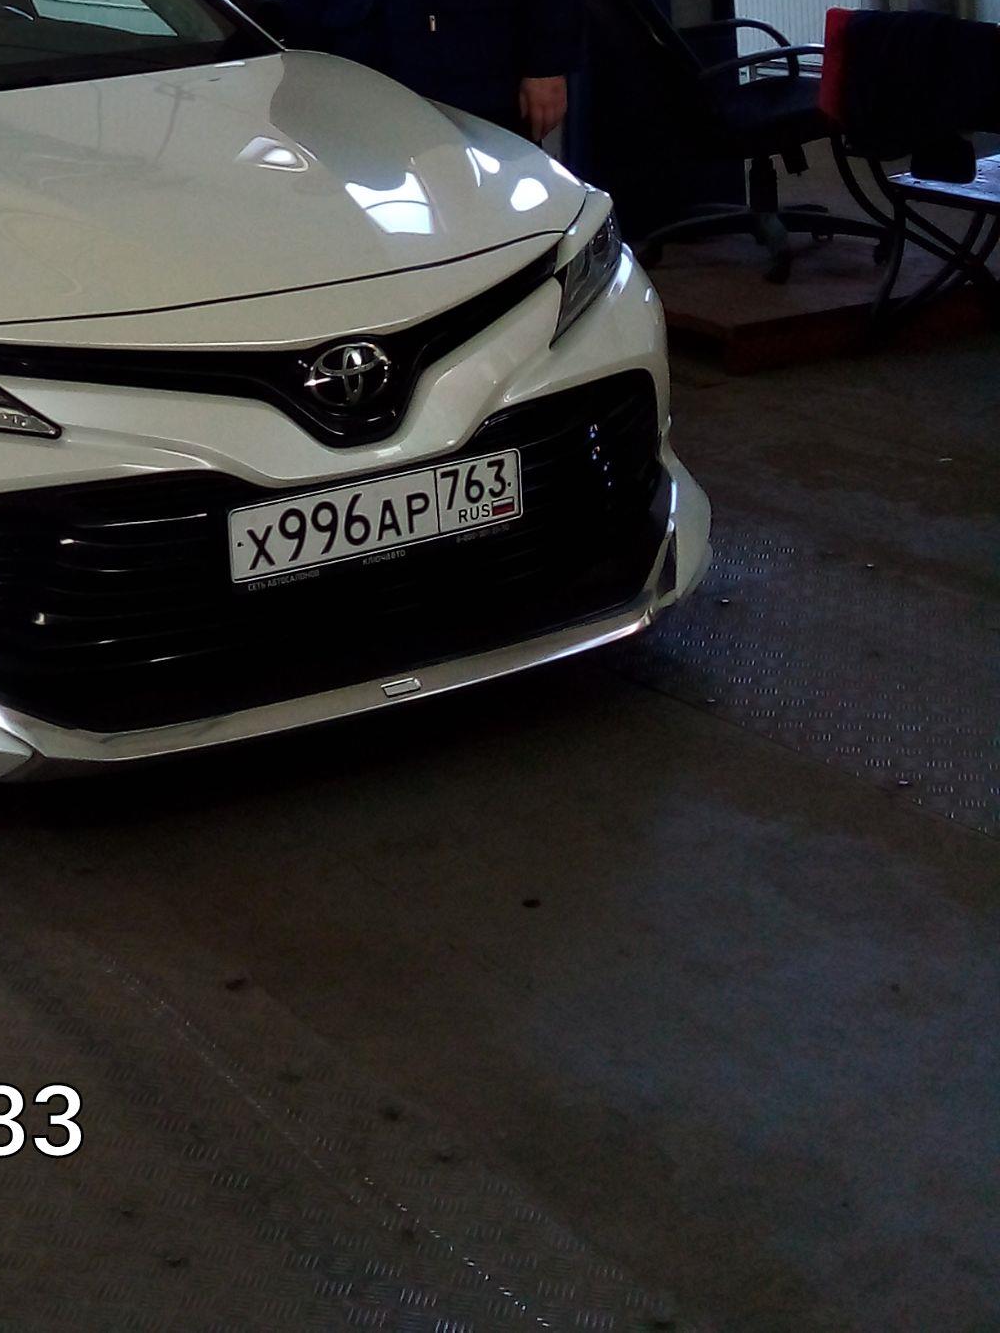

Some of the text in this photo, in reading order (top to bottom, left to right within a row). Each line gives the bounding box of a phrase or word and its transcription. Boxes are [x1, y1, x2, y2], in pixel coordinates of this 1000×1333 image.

[246, 458, 507, 571] Х996АР 763
[458, 503, 491, 524] RUS
